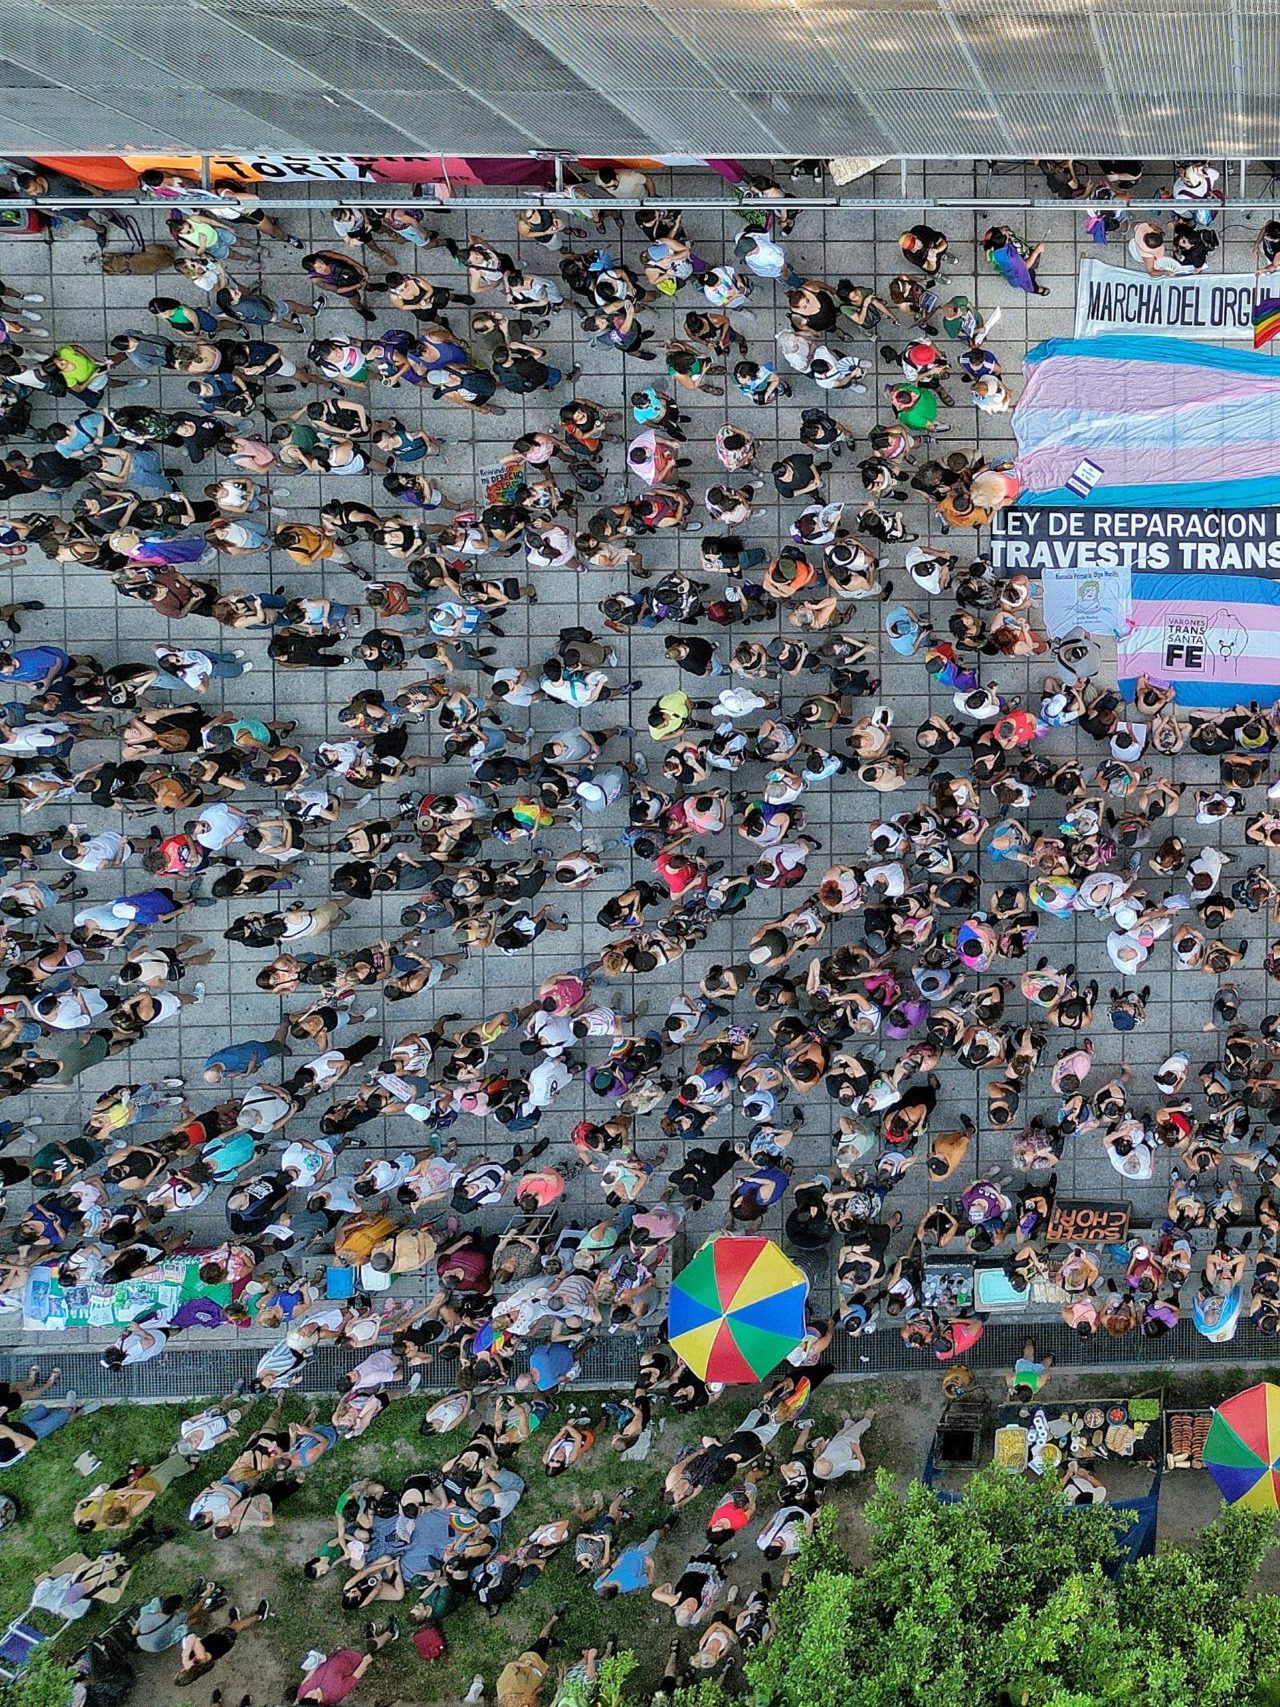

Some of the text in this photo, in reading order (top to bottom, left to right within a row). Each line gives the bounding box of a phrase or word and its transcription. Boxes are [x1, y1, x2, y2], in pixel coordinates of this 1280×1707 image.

[1086, 281, 1162, 325] MARCHA
[1166, 285, 1206, 327] DEL
[991, 511, 1042, 536] LEY
[1049, 511, 1085, 537] DE
[1093, 512, 1266, 538] REPARACION
[990, 540, 1170, 570] TRAVESTIS
[1167, 624, 1205, 635] TRANS
[1168, 618, 1206, 627] VARONES
[1168, 633, 1204, 645] SANTA
[1165, 643, 1204, 668] FE
[1053, 1208, 1127, 1227] CHORI
[1047, 1223, 1121, 1241] SUPER
